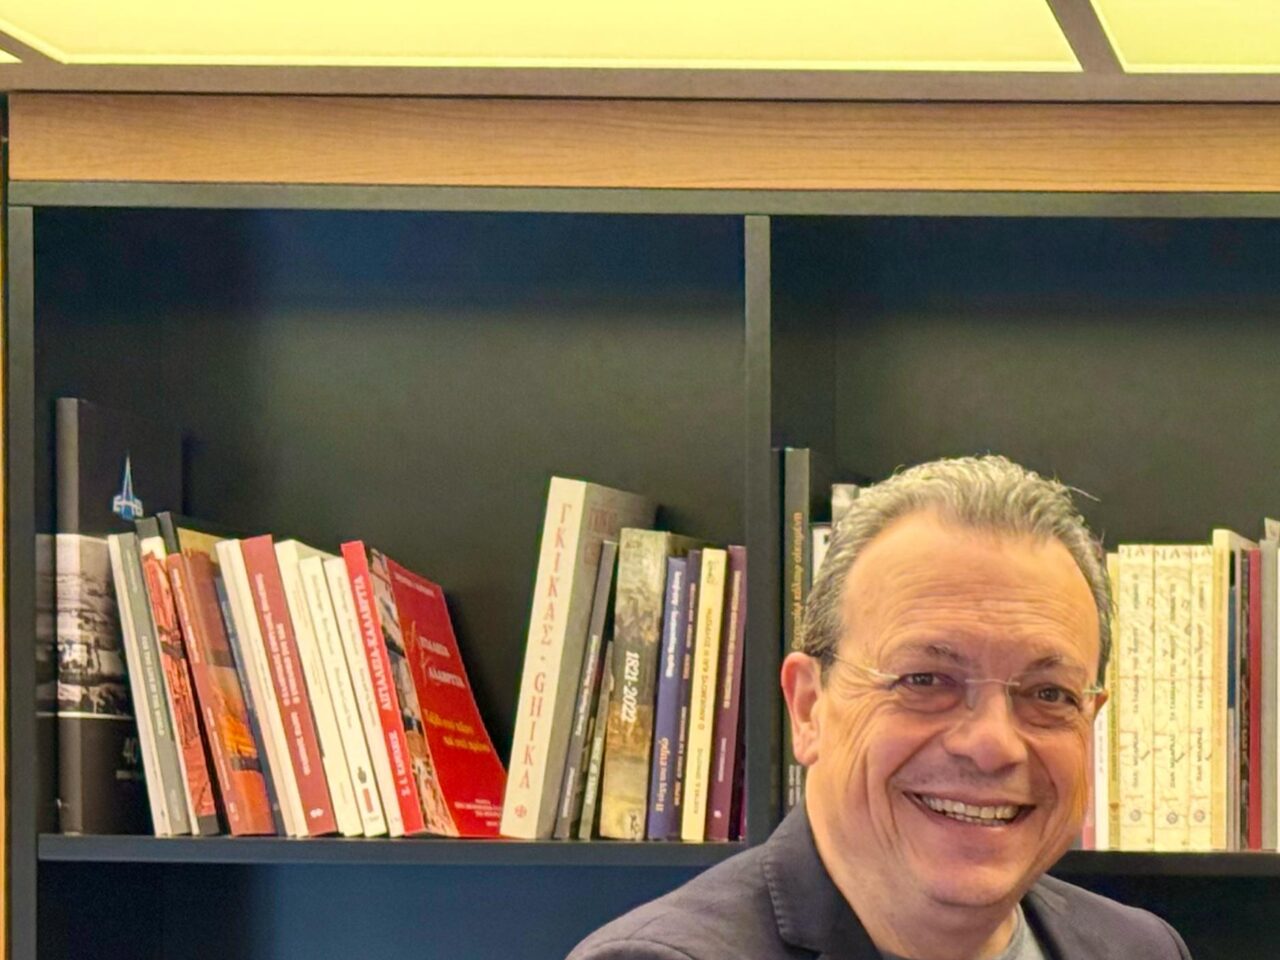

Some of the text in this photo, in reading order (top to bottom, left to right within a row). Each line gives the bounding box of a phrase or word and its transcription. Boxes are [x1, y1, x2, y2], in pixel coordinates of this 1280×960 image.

[517, 502, 572, 789] ΓΚΙΚΑΣ GHIKA
[620, 650, 639, 723] 1821-2022
